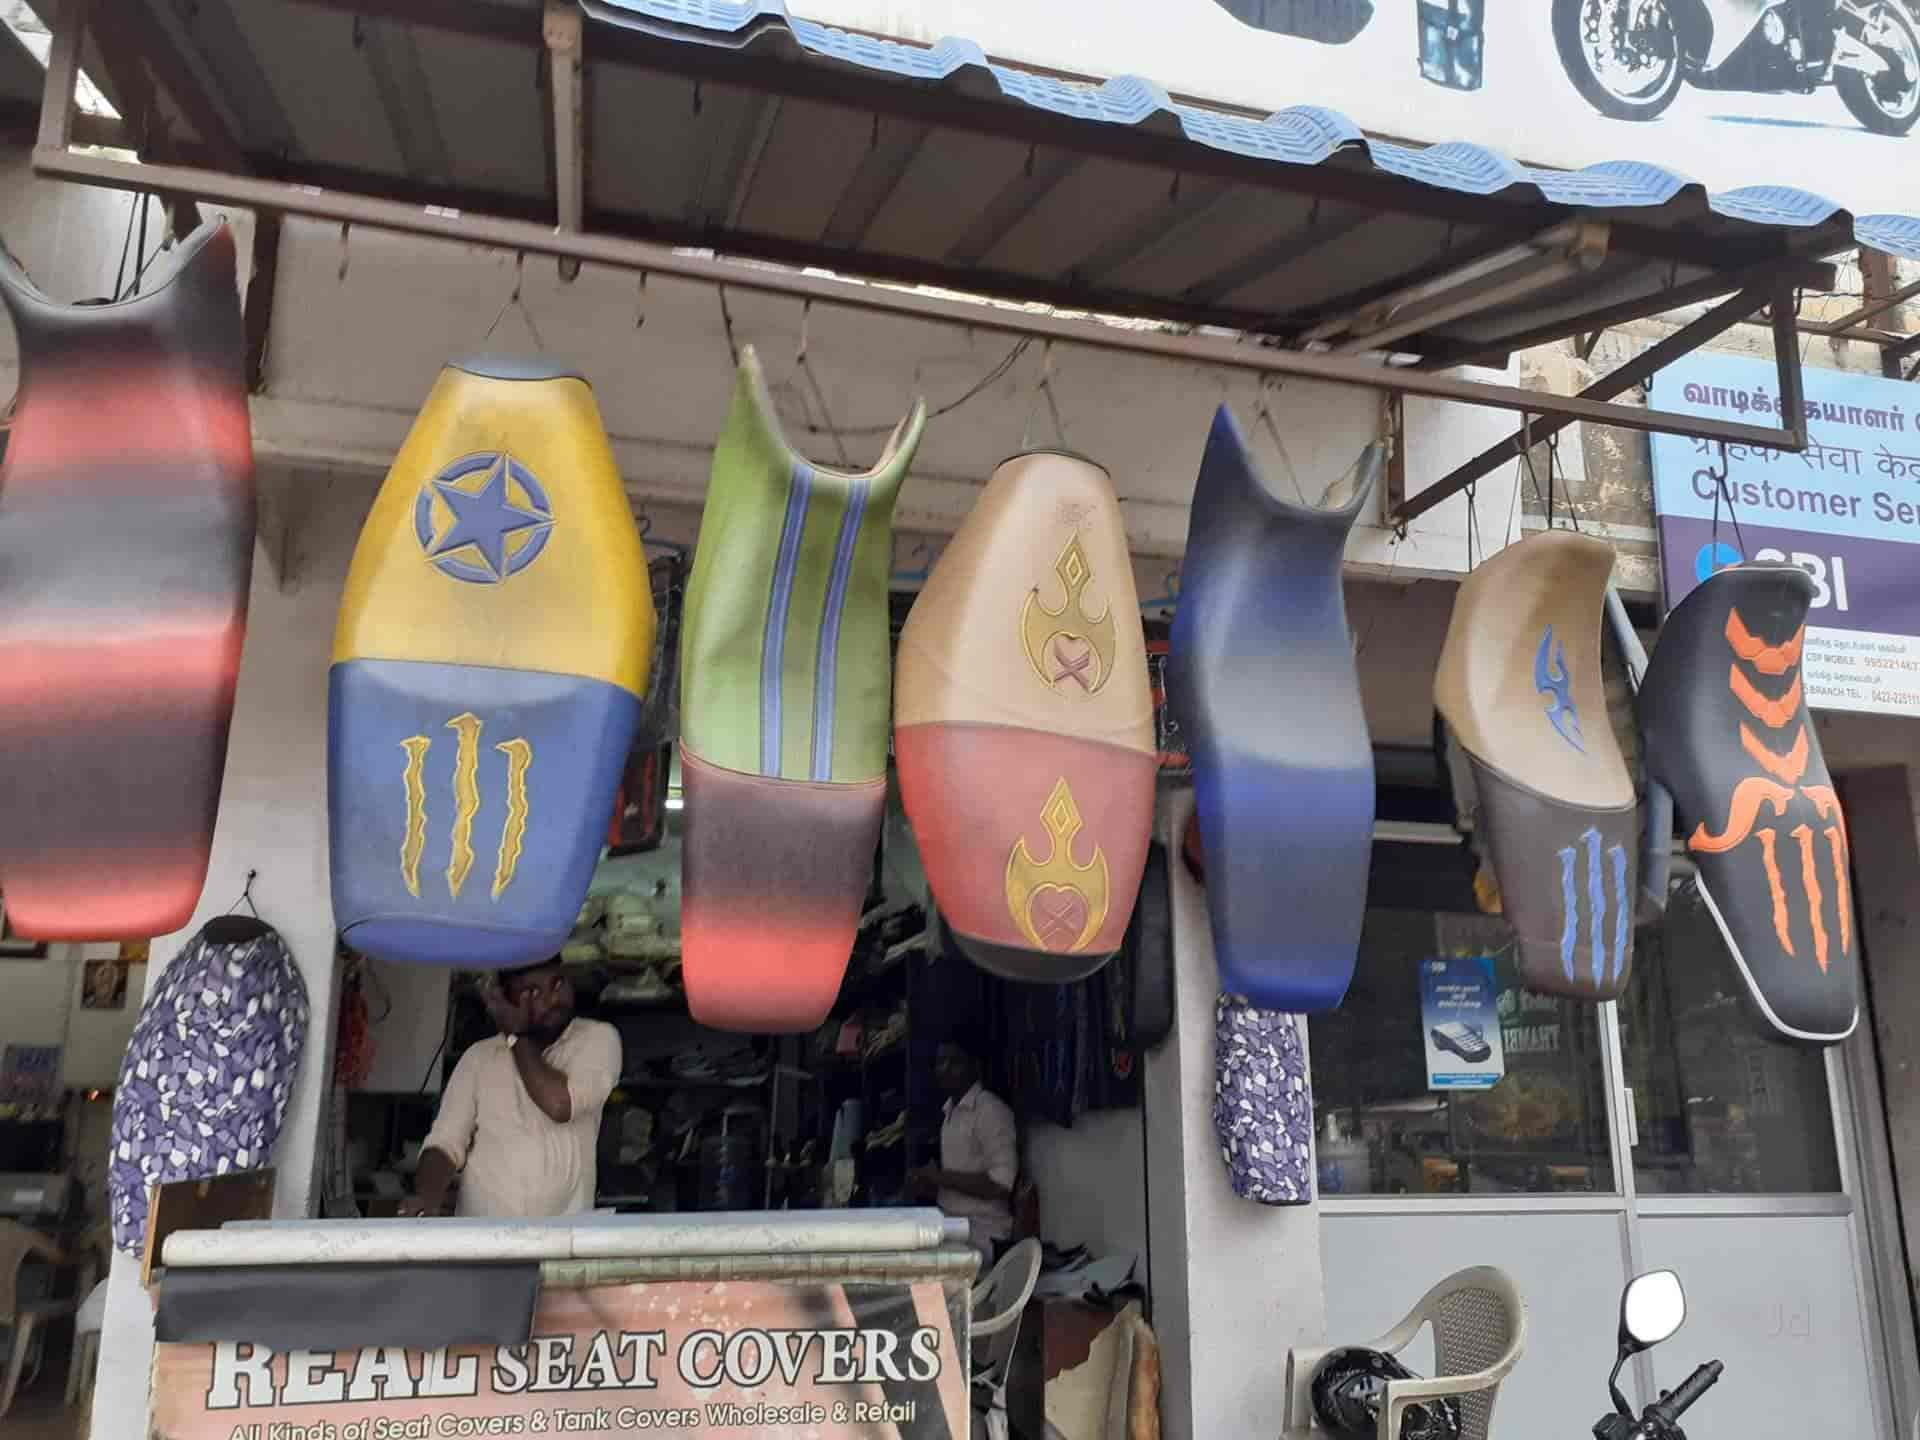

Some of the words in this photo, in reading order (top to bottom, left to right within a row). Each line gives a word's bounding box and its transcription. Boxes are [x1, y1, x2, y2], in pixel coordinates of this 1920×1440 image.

[1683, 382, 1904, 432] வாடிக்கயாளர்
[1692, 468, 1861, 518] Customer
[1754, 547, 1849, 612] BI
[206, 1340, 479, 1410] REAL
[491, 1329, 667, 1393] SEAT
[677, 1325, 942, 1389] COVERS
[230, 1423, 263, 1440] All
[268, 1419, 336, 1440] Kinds
[343, 1414, 369, 1439] of
[375, 1414, 432, 1438] Seat
[437, 1410, 525, 1436] Covers
[530, 1408, 548, 1432] &
[553, 1407, 609, 1432] Tank
[616, 1406, 699, 1429] Covers
[704, 1401, 825, 1426] Wholesale
[832, 1402, 848, 1424] &
[855, 1400, 917, 1424] Retail
